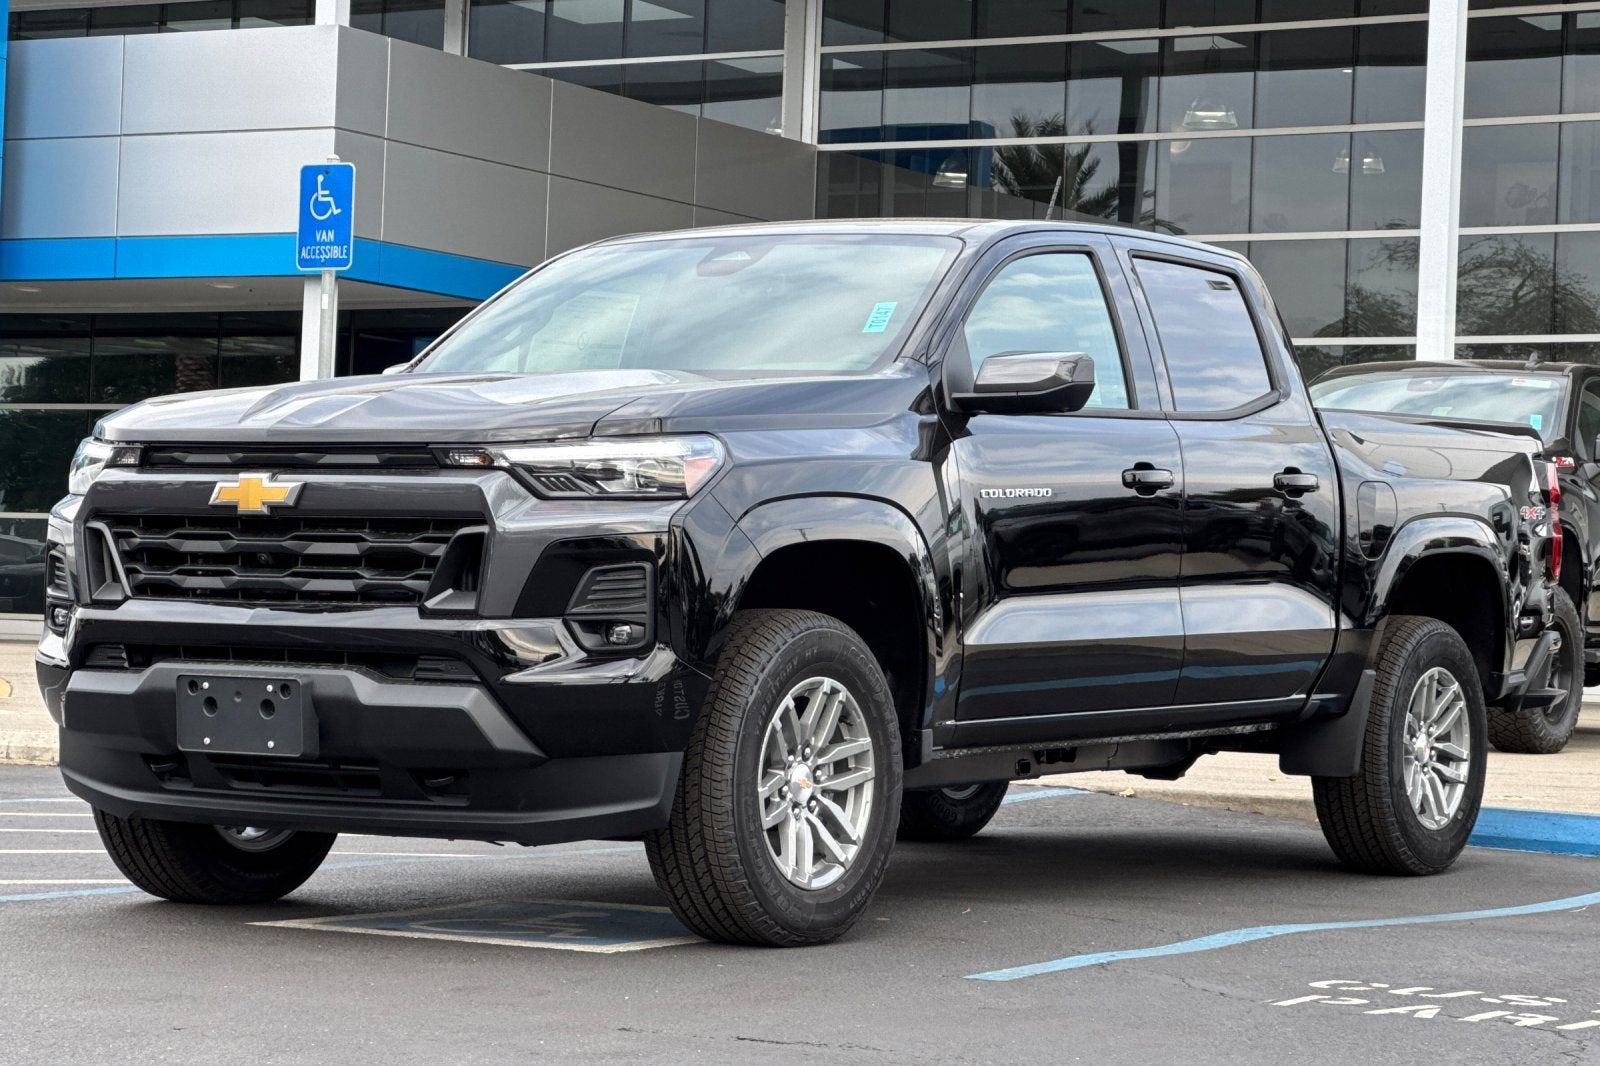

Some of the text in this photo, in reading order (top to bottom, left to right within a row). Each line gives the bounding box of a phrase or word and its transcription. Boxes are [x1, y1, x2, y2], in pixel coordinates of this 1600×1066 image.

[315, 229, 335, 242] VAN
[301, 245, 348, 259] ACCESSIBLE
[980, 485, 1052, 498] COLORADO
[1308, 979, 1600, 1013] CUS
